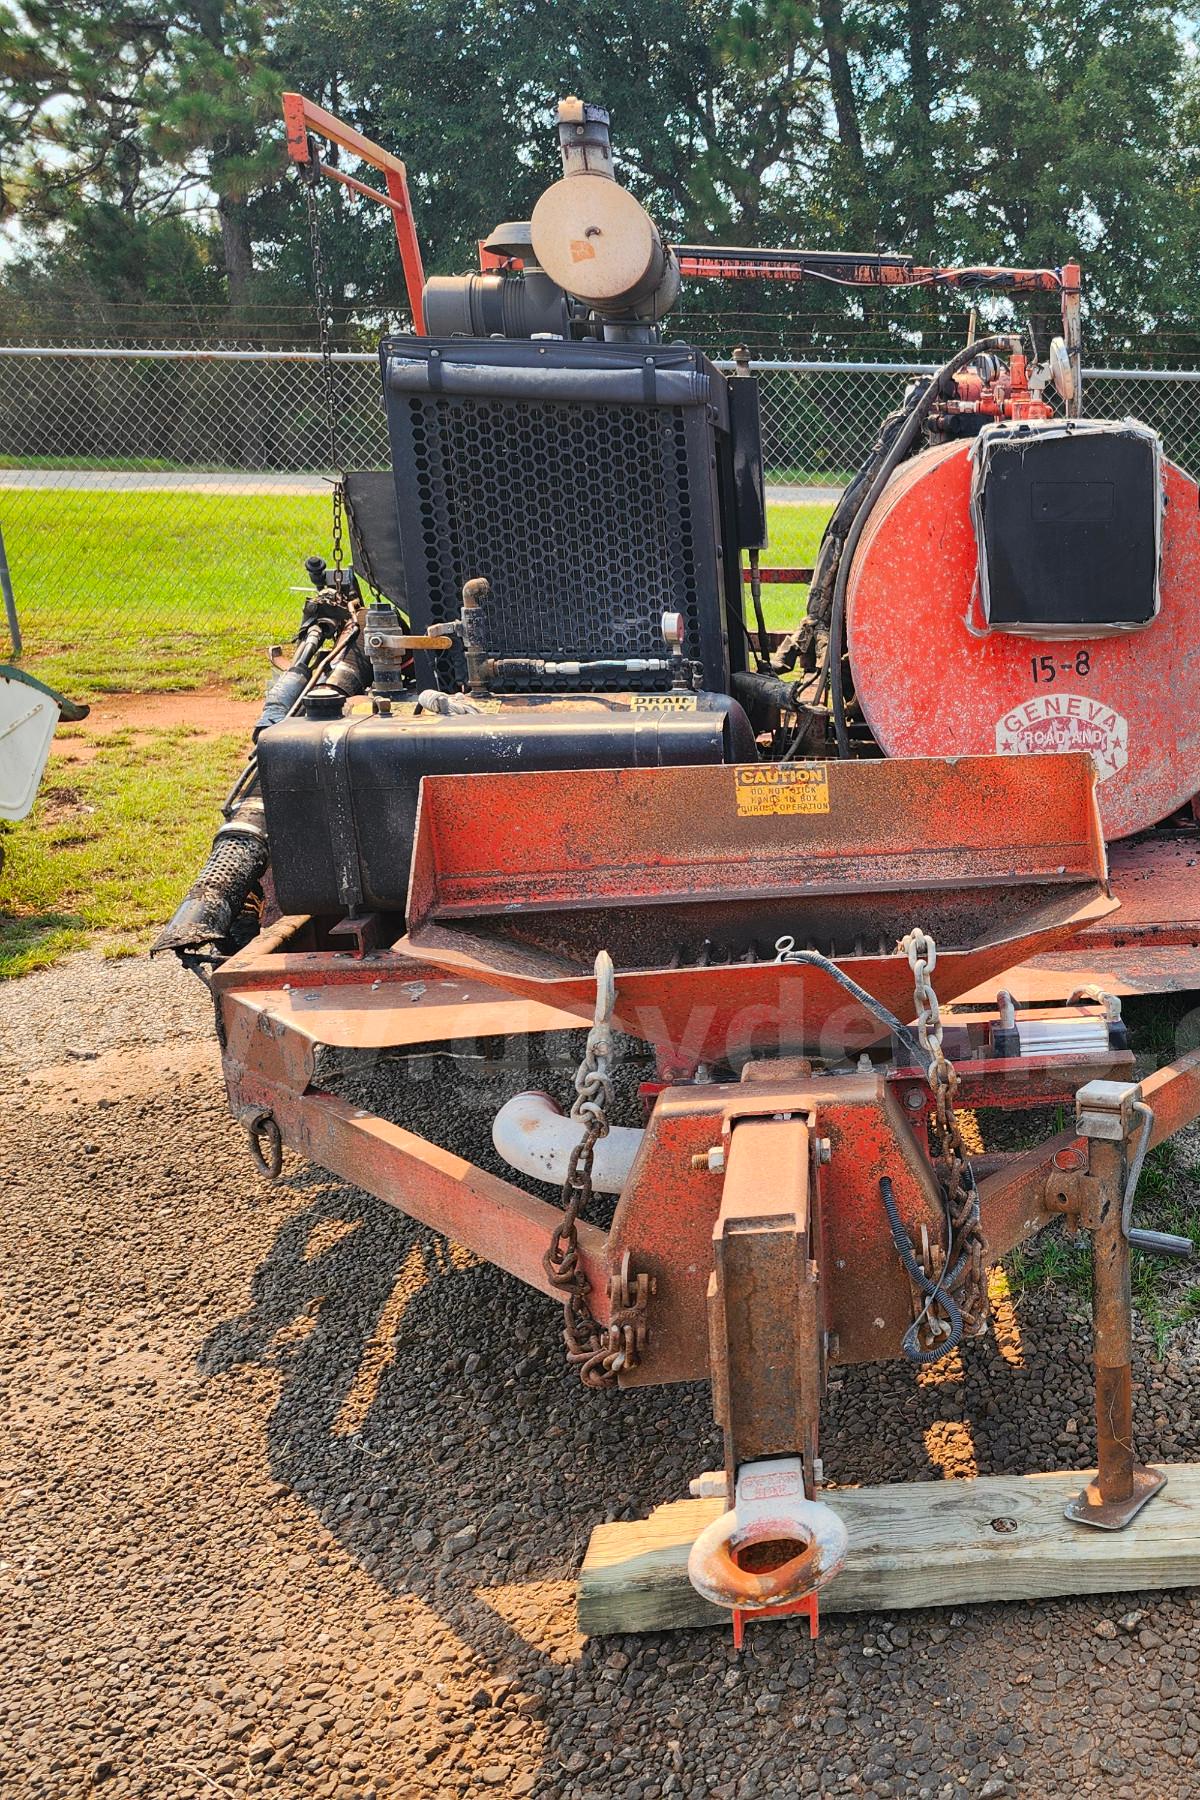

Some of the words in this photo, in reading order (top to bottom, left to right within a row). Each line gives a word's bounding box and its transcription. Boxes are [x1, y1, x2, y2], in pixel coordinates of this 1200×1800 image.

[1031, 650, 1090, 683] 15-8
[1003, 697, 1117, 733] GENEVA
[1024, 730, 1065, 745] ROAD
[1071, 730, 1102, 744] AND
[741, 769, 823, 784] CAUTION
[768, 787, 785, 795] NOT
[791, 785, 817, 794] STICK
[800, 794, 817, 802] BOX
[780, 802, 829, 811] OPERATION
